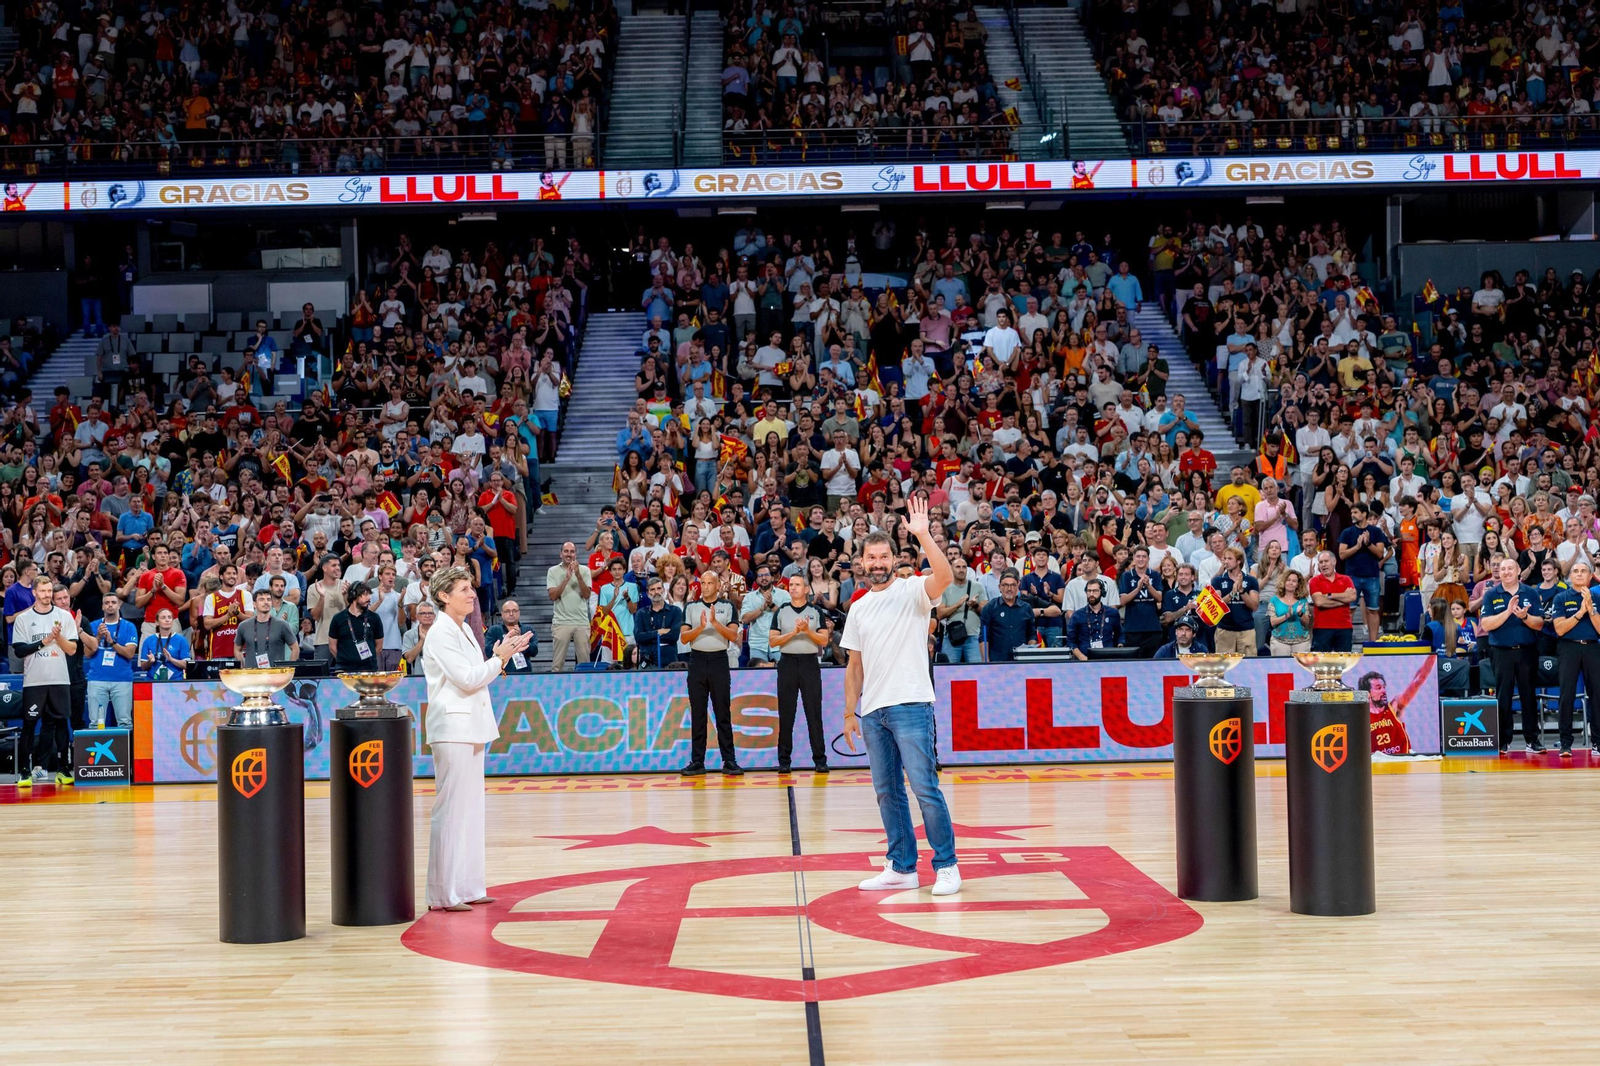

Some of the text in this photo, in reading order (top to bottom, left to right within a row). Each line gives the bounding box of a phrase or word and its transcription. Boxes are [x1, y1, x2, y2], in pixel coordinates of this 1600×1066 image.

[1225, 153, 1581, 182] GRACIAS Sergio LLULL
[693, 164, 1052, 193] GRACIAS Sergio LLULL
[159, 175, 519, 204] GRACIAS Sergio LLULL
[210, 710, 227, 719] FEB
[1370, 718, 1394, 732] SPAÑA
[1376, 733, 1391, 746] 23
[1448, 738, 1494, 748] CaixaBank
[78, 768, 124, 778] CaixaBank
